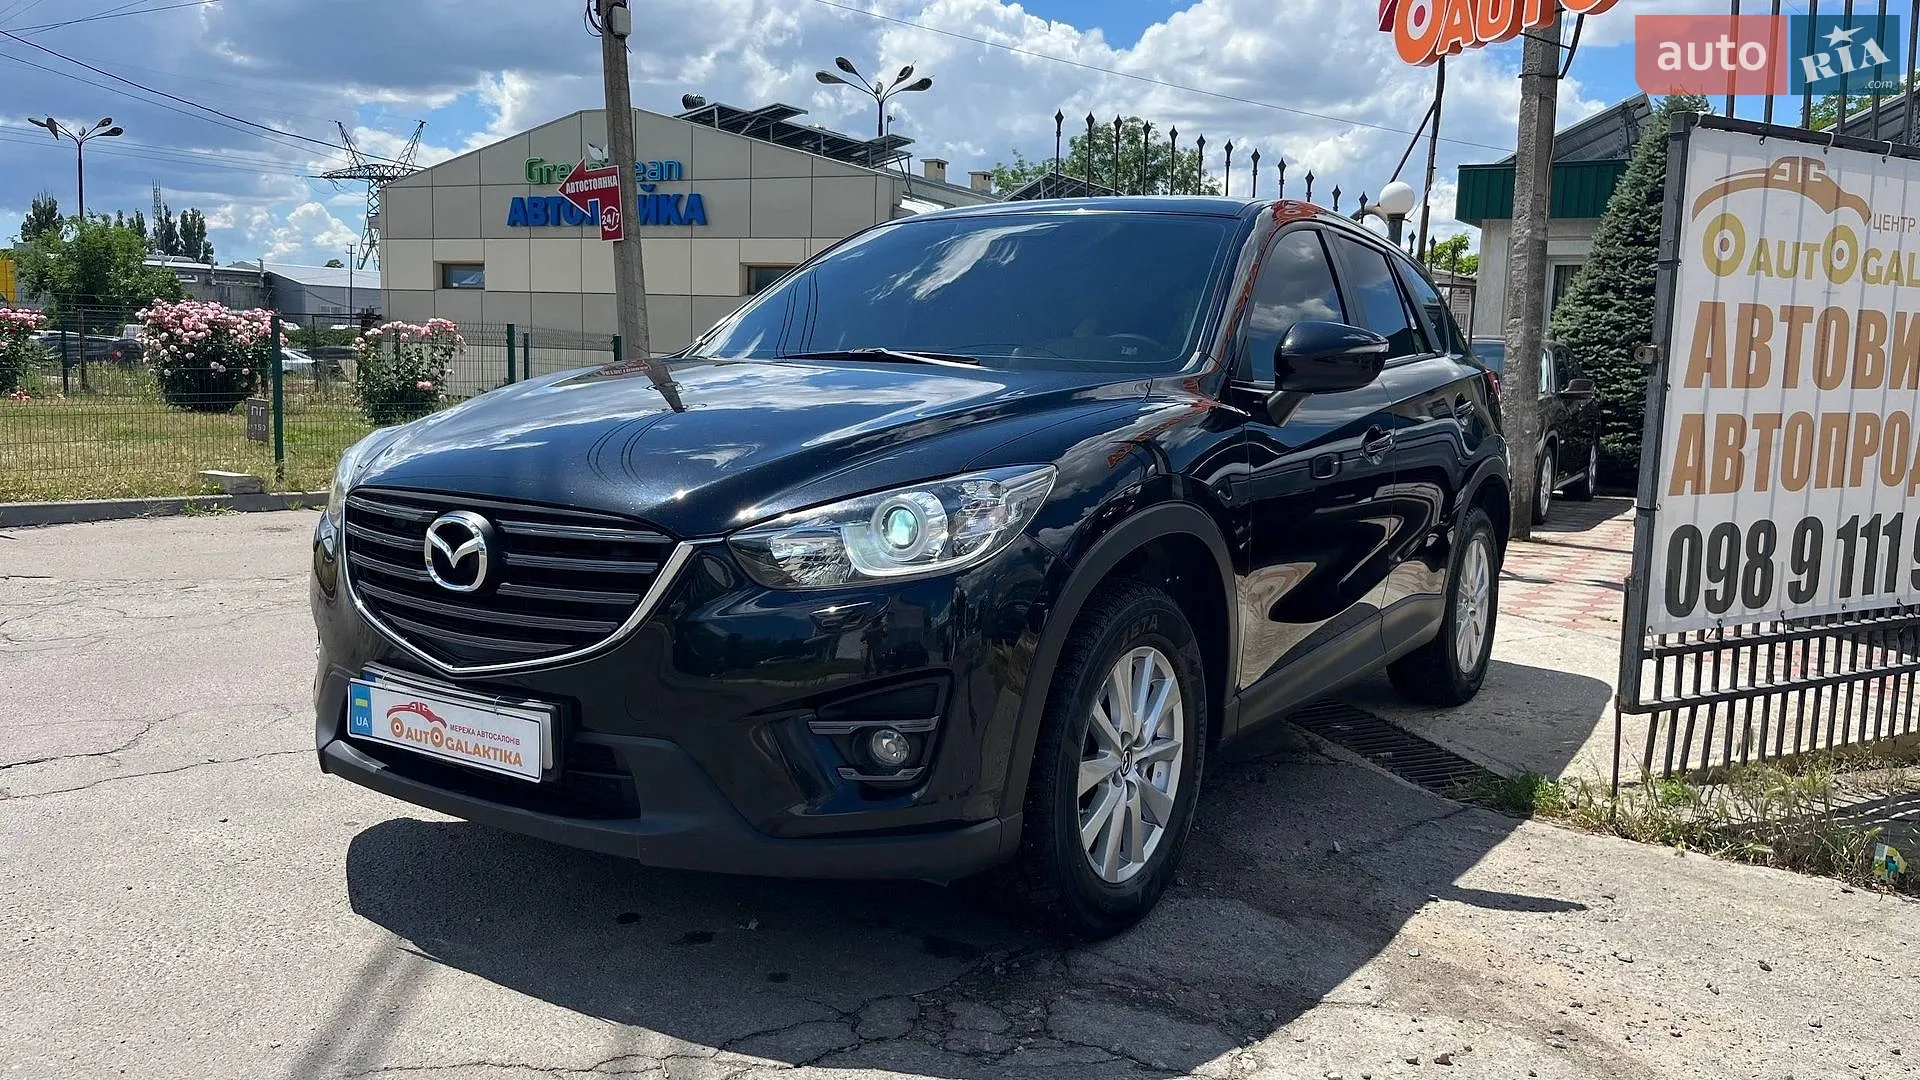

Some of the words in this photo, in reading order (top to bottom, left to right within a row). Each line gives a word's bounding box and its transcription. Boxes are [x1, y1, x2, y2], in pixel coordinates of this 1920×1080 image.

[565, 175, 618, 194] АВТОСТОЯНКА
[601, 212, 620, 226] 24/7
[1873, 213, 1916, 234] ЦЕНТР
[1664, 519, 1777, 618] 098
[1787, 516, 1824, 604] 9
[356, 716, 369, 729] UA
[450, 724, 476, 737] МЕРЕЖА
[477, 730, 521, 746] АВТОСАЛОНІВ
